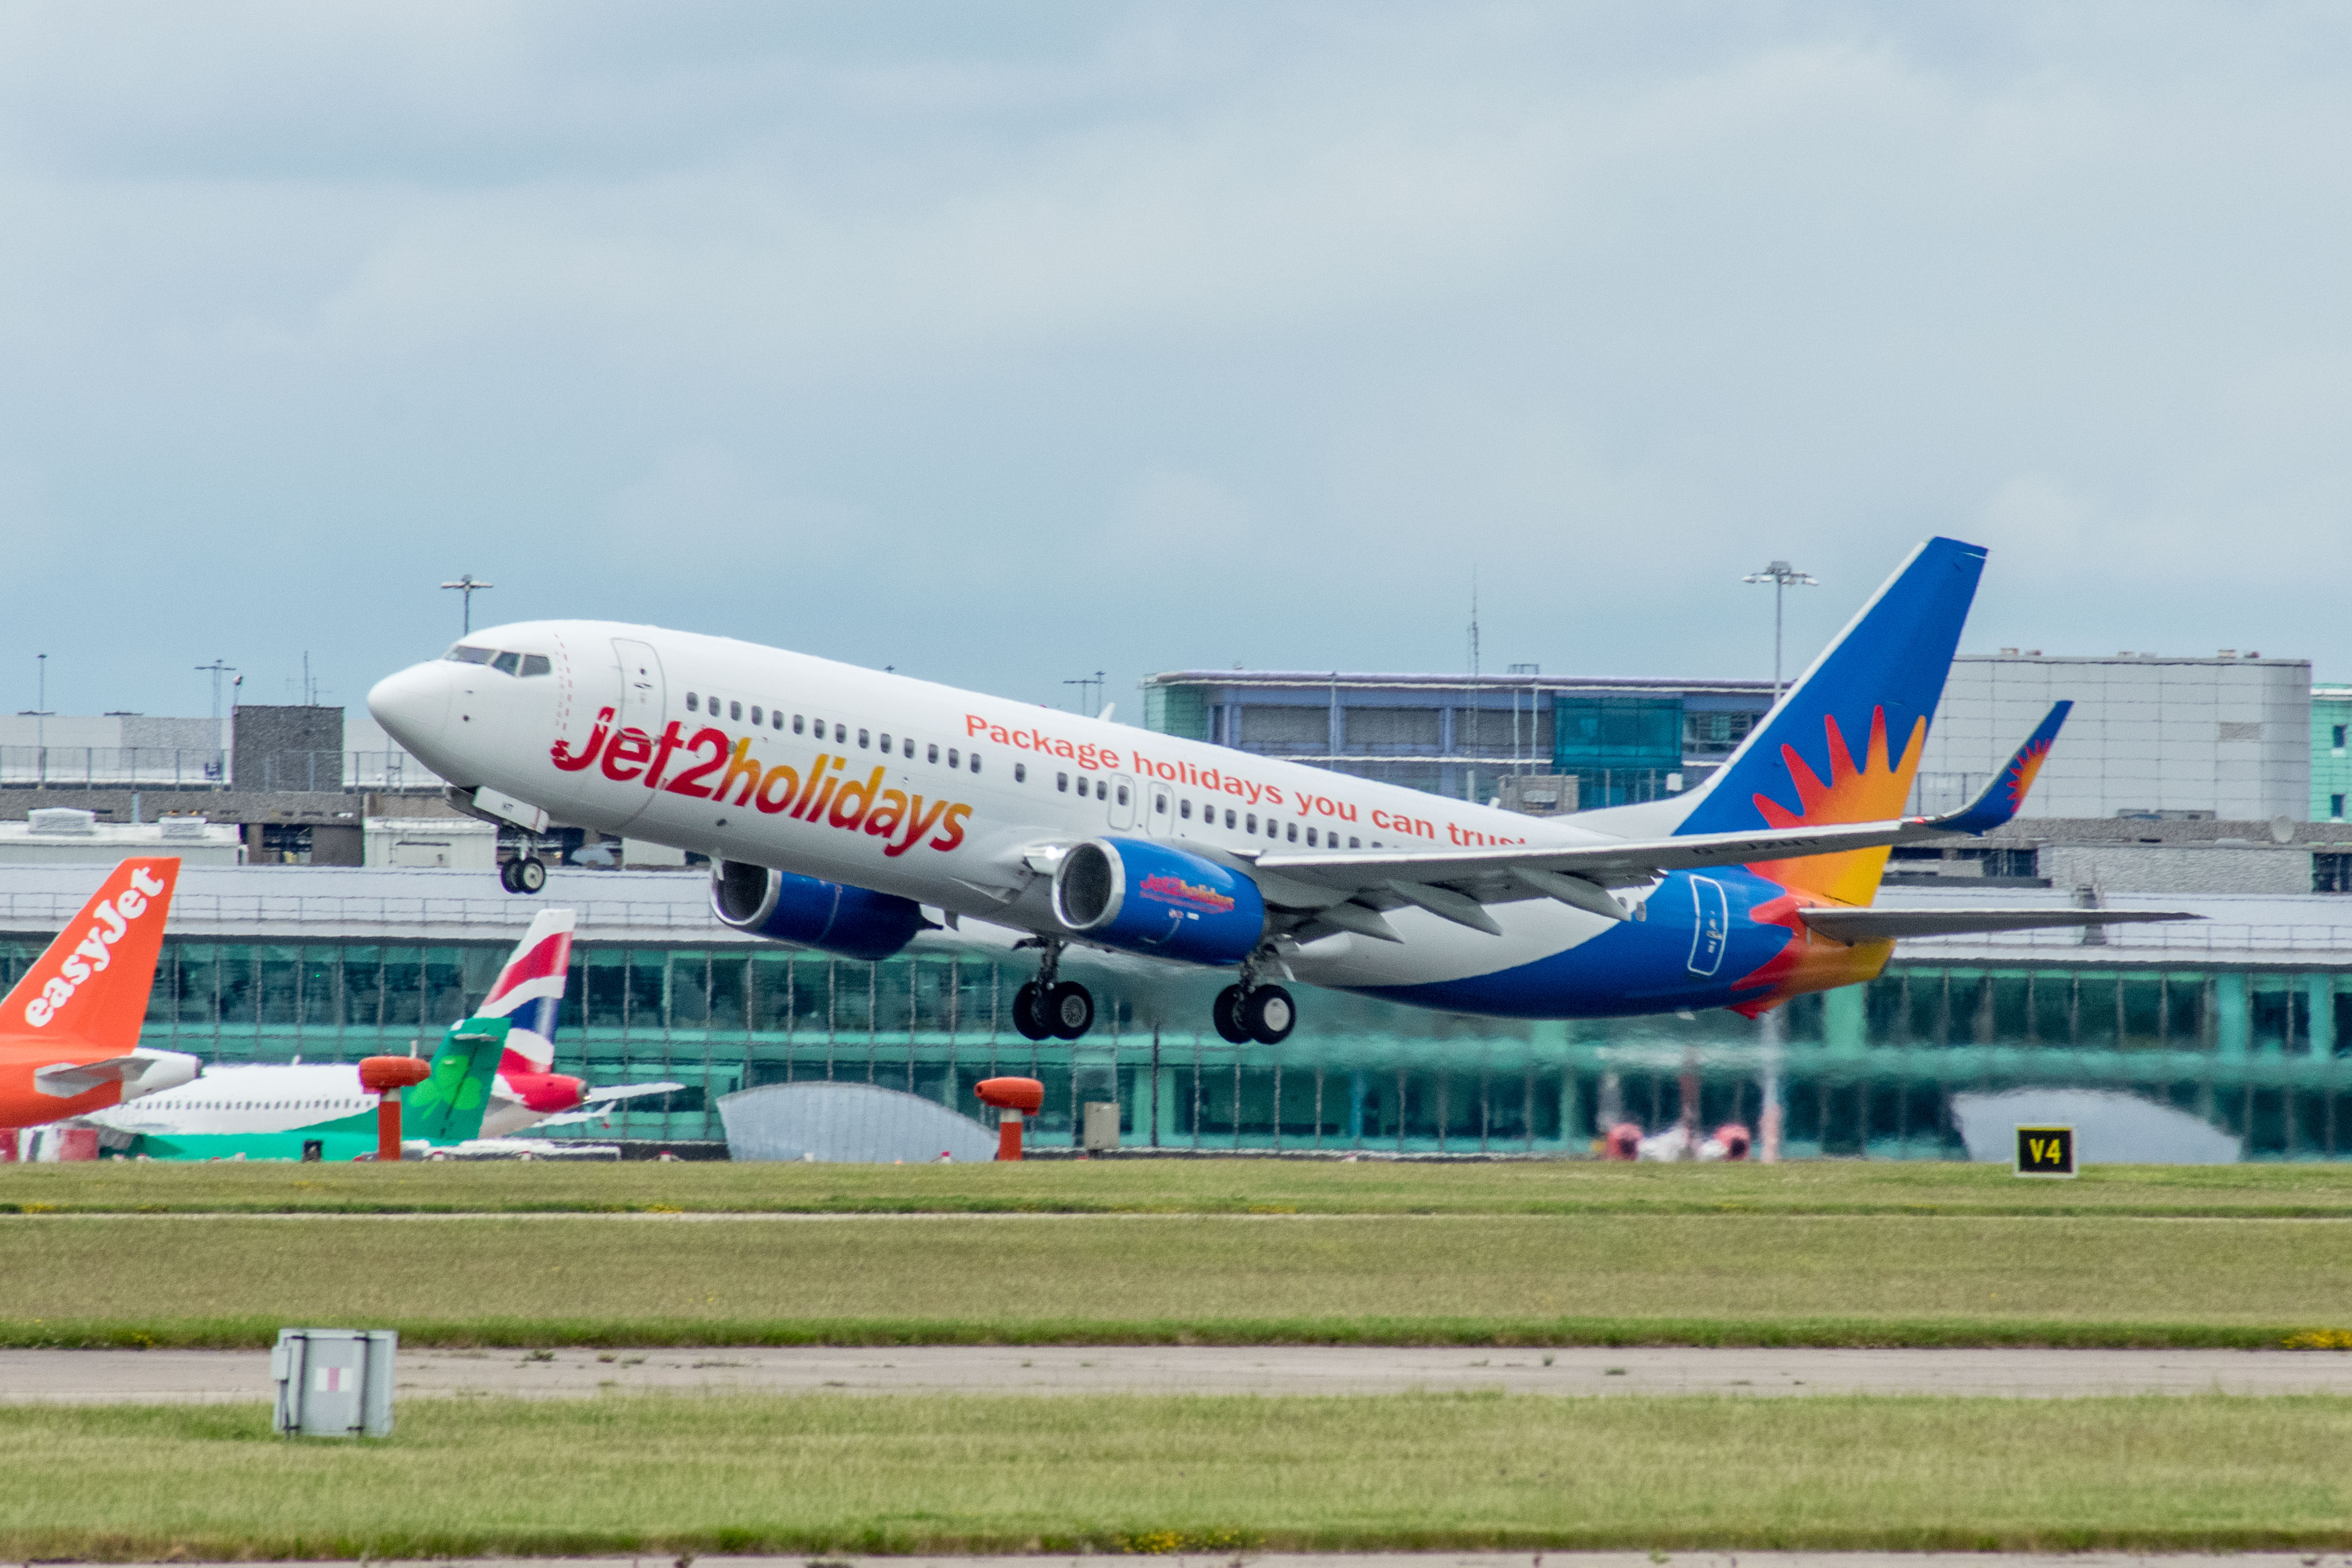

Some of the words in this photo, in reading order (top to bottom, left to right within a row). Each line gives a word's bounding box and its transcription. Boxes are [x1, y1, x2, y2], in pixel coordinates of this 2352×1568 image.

[965, 714, 1120, 771] Package
[1133, 750, 1284, 805] holidays
[1295, 792, 1357, 817] you
[1371, 809, 1435, 839] can
[25, 866, 164, 1027] easyJet
[2029, 1138, 2061, 1164] V4
